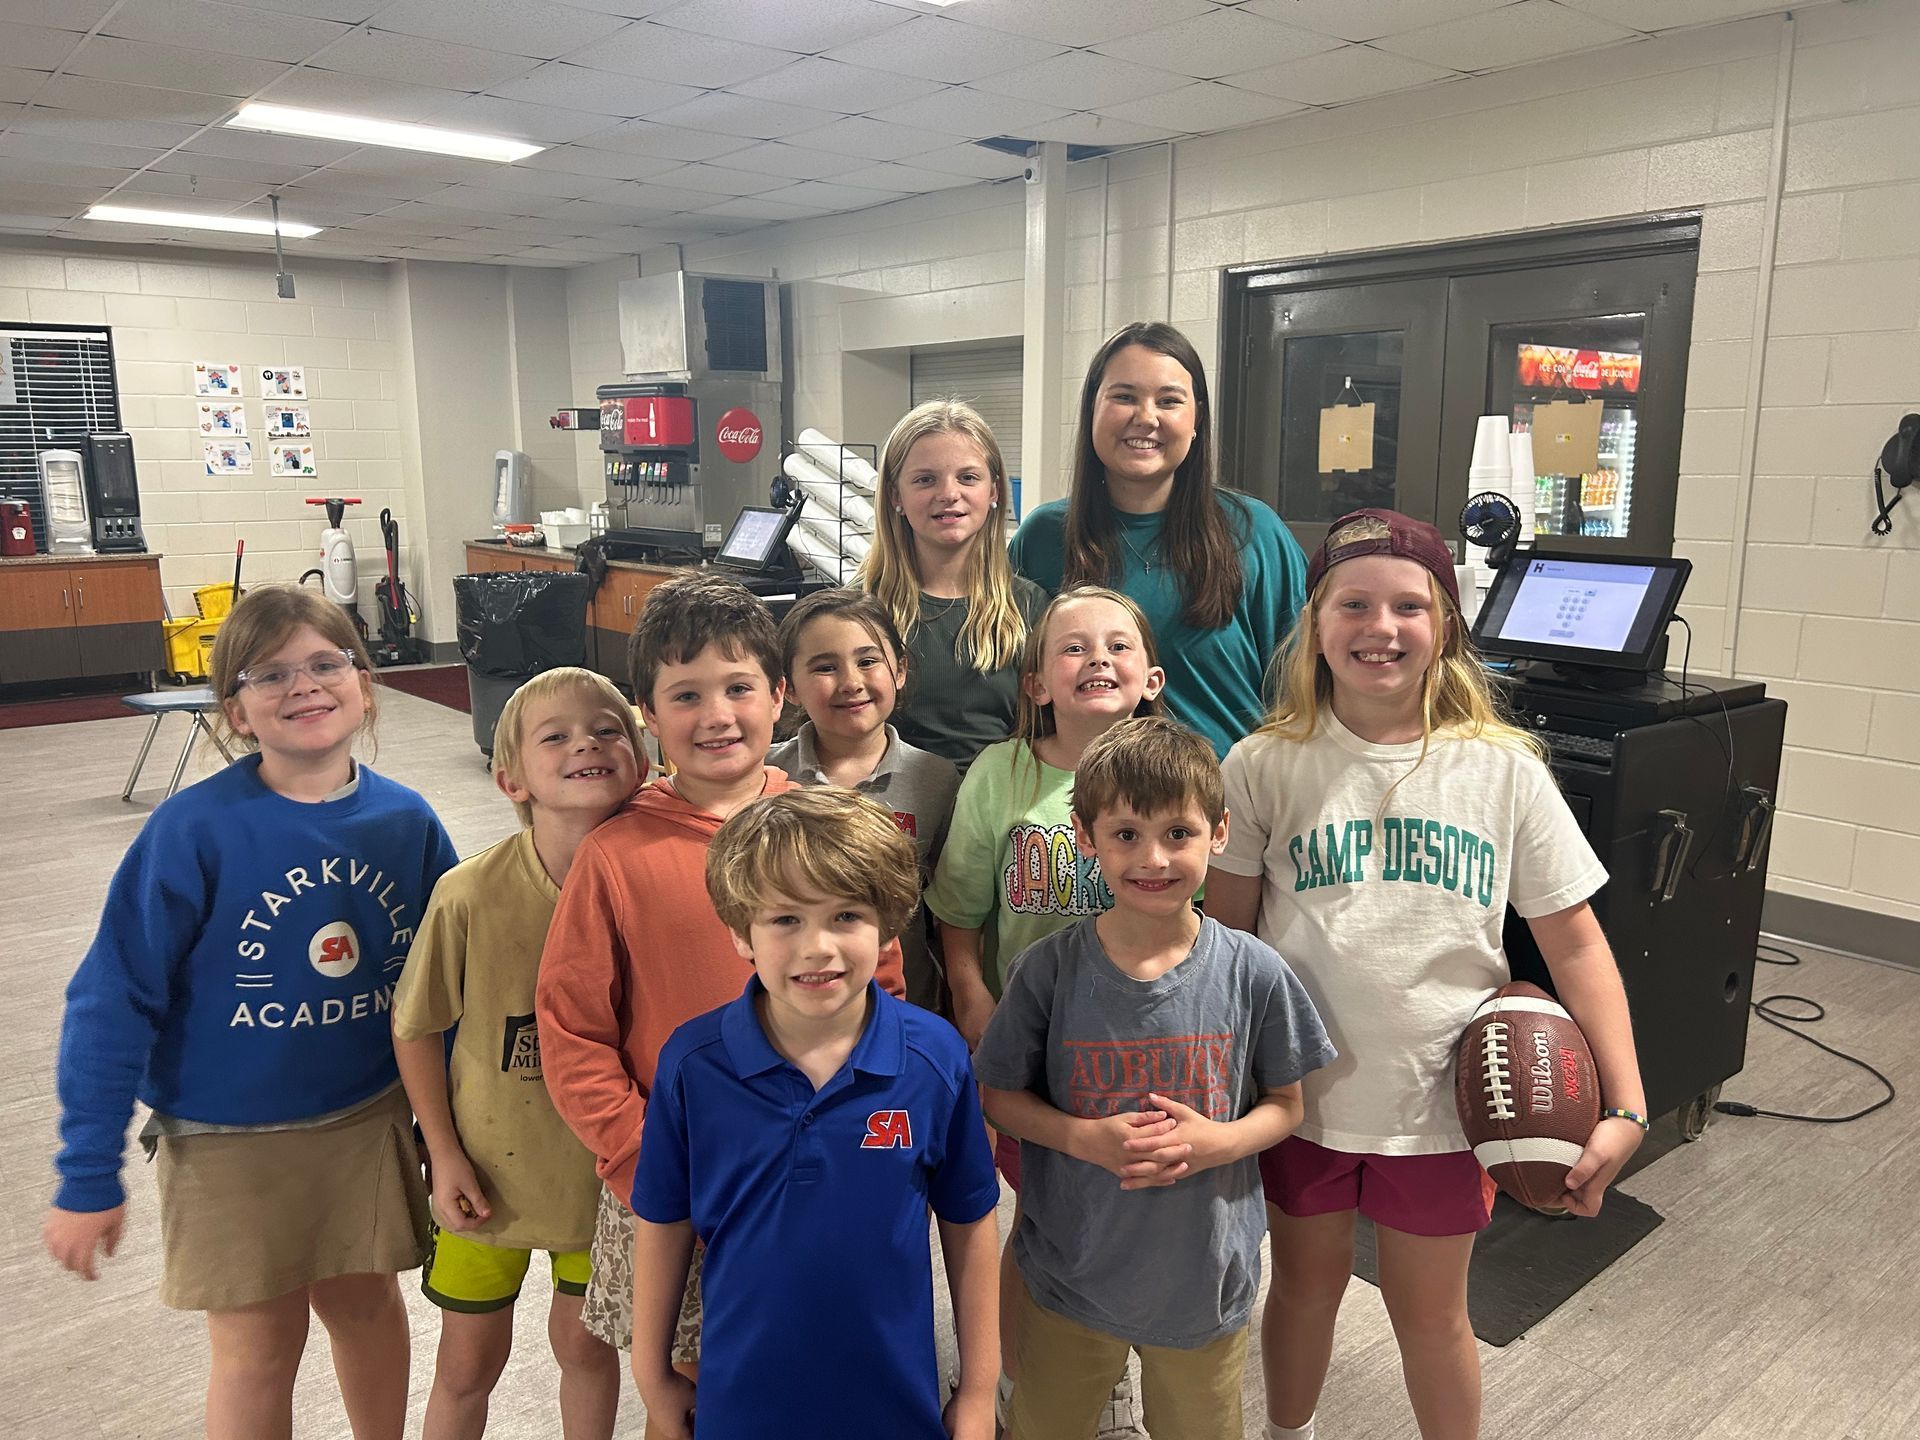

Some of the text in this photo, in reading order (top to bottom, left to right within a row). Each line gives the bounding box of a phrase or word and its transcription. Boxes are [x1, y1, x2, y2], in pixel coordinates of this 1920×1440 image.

[1601, 367, 1633, 379] DELICIOUS
[718, 425, 761, 444] Coca-Cola
[1288, 817, 1495, 909] CAMP DESOTO
[237, 856, 414, 961] STARKVILLE
[317, 934, 355, 964] SA
[229, 981, 397, 1029] ACADEM
[1070, 1041, 1233, 1091] AUBURN
[1530, 1030, 1555, 1114] Wilson
[860, 1109, 913, 1149] SA
